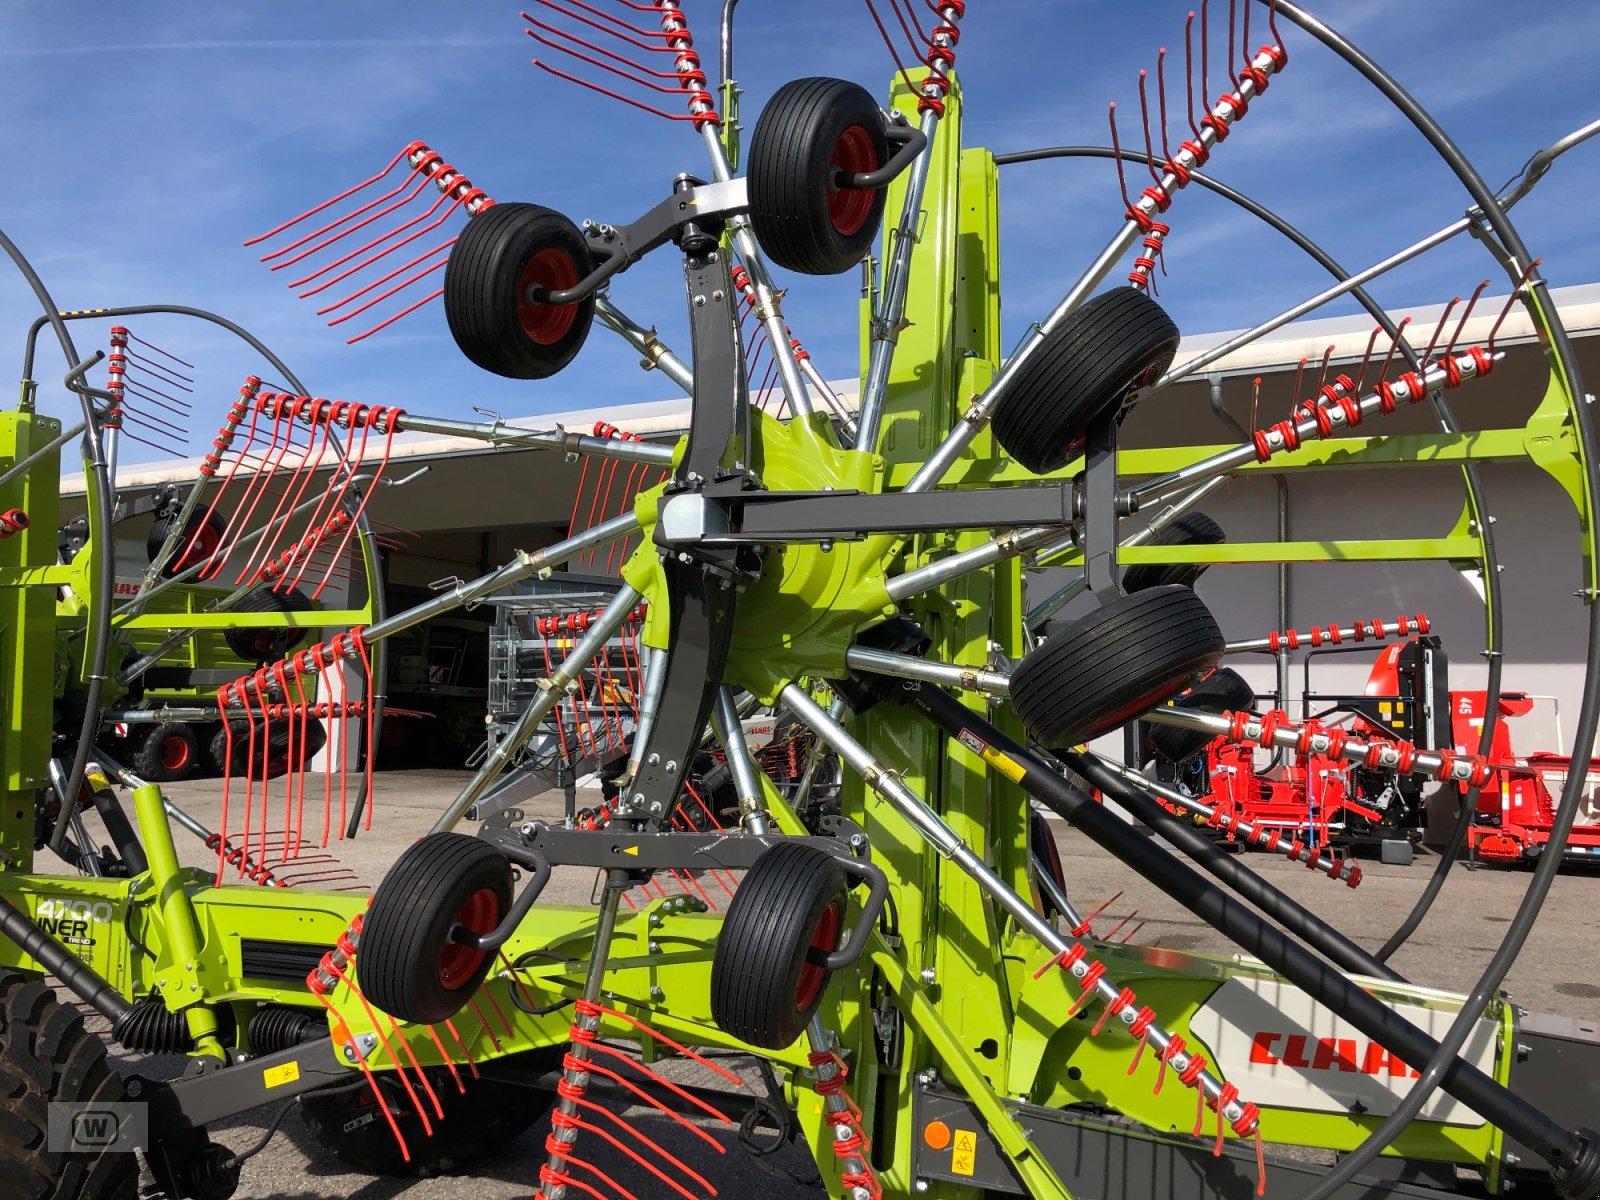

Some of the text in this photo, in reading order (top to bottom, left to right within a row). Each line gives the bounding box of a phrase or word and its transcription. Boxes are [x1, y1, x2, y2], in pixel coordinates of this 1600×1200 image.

[37, 898, 113, 923] 4700
[36, 916, 88, 937] INER
[1249, 1031, 1422, 1079] CLAA
